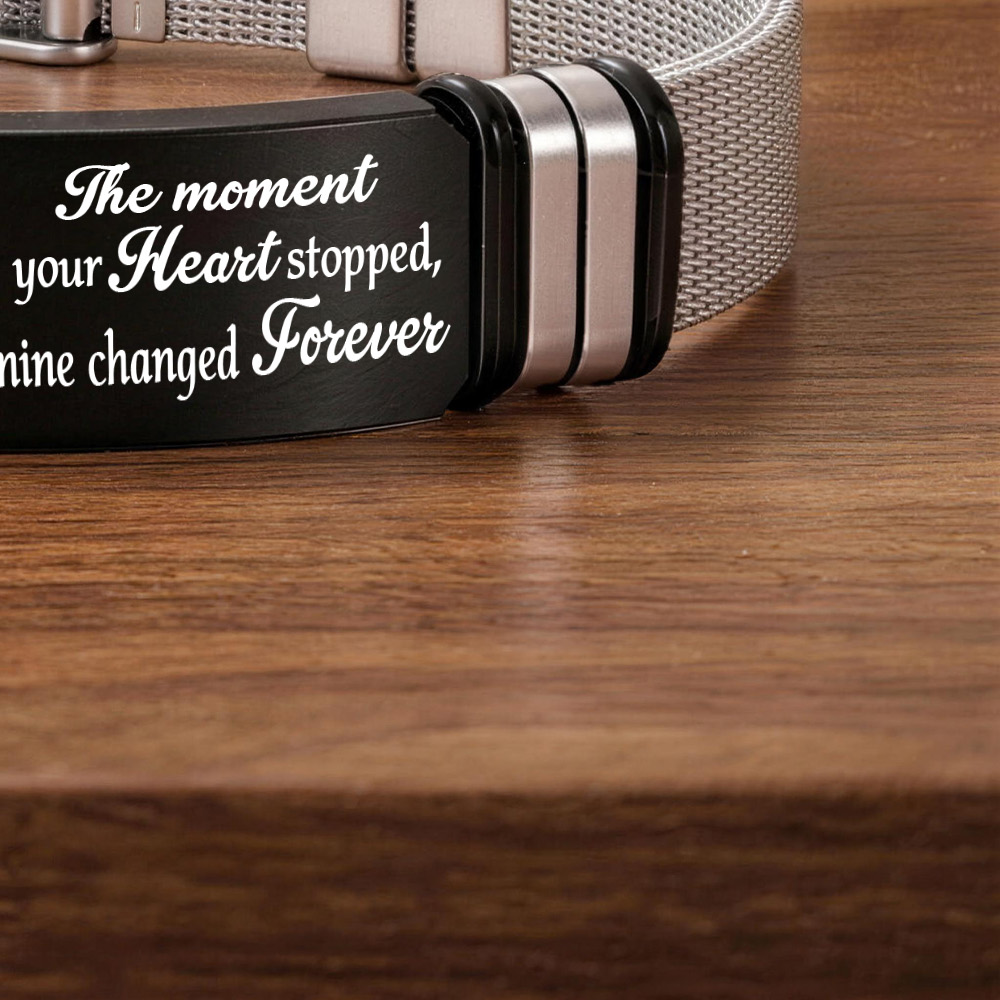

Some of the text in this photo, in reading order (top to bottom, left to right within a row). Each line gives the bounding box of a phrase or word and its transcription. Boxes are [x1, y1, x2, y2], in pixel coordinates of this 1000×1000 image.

[55, 153, 379, 221] The moment
[11, 221, 442, 306] your Heart stopped,
[87, 323, 240, 401] changed
[251, 293, 451, 377] Forever
